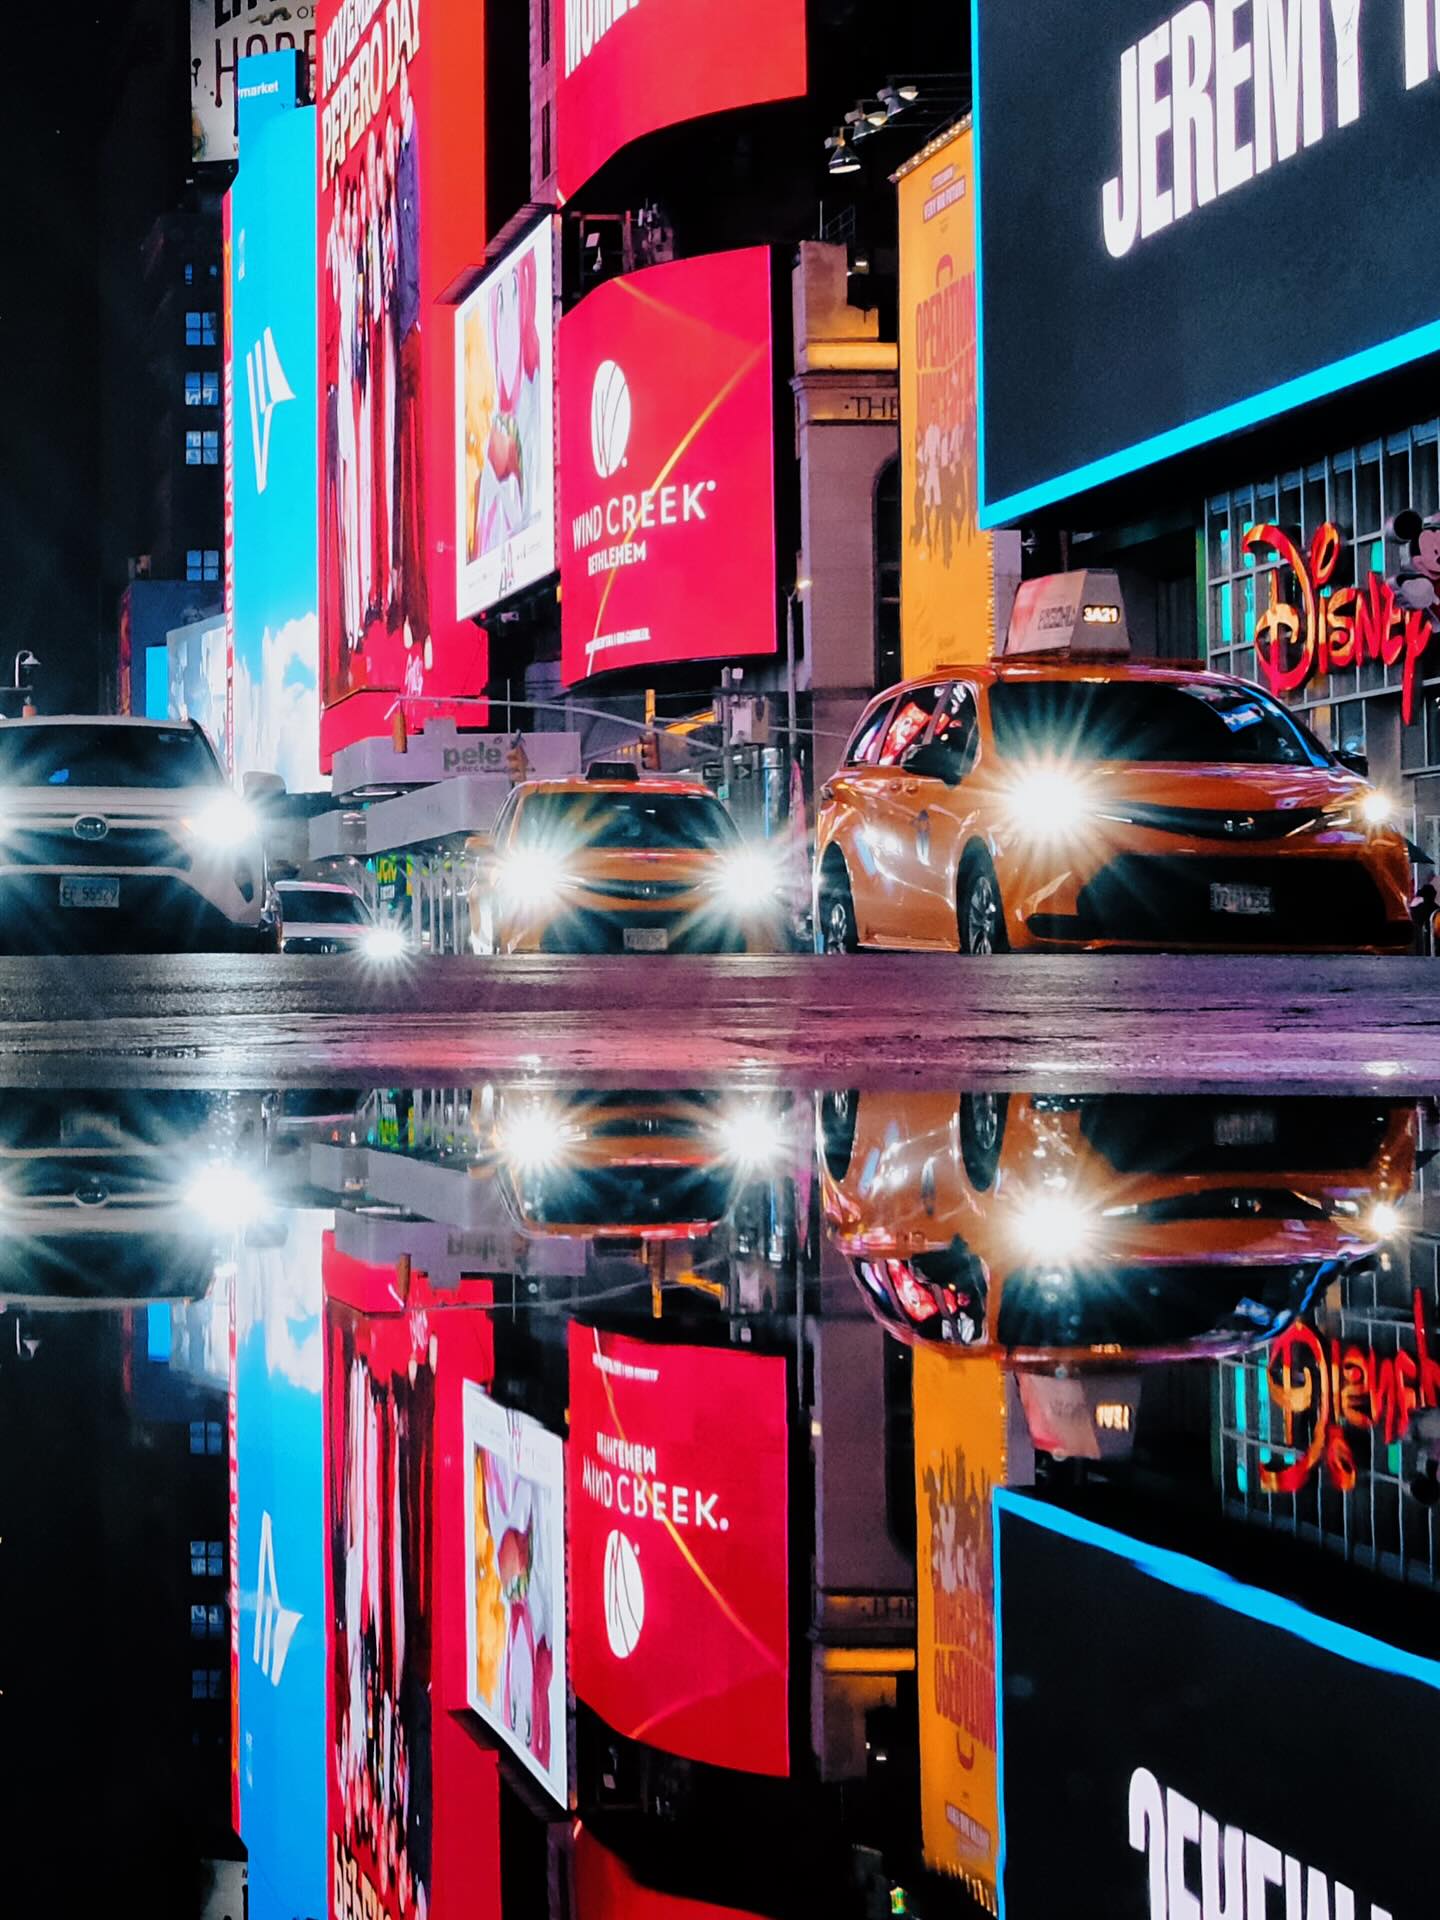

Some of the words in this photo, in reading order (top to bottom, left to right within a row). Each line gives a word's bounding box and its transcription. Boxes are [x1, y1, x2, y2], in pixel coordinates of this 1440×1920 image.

[322, 21, 384, 192] PEPERO
[386, 0, 420, 94] DAY
[1102, 0, 1361, 258] JEREMY
[572, 505, 603, 552] WIND
[606, 482, 706, 535] CREEK
[588, 540, 647, 577] BETHLEHEM
